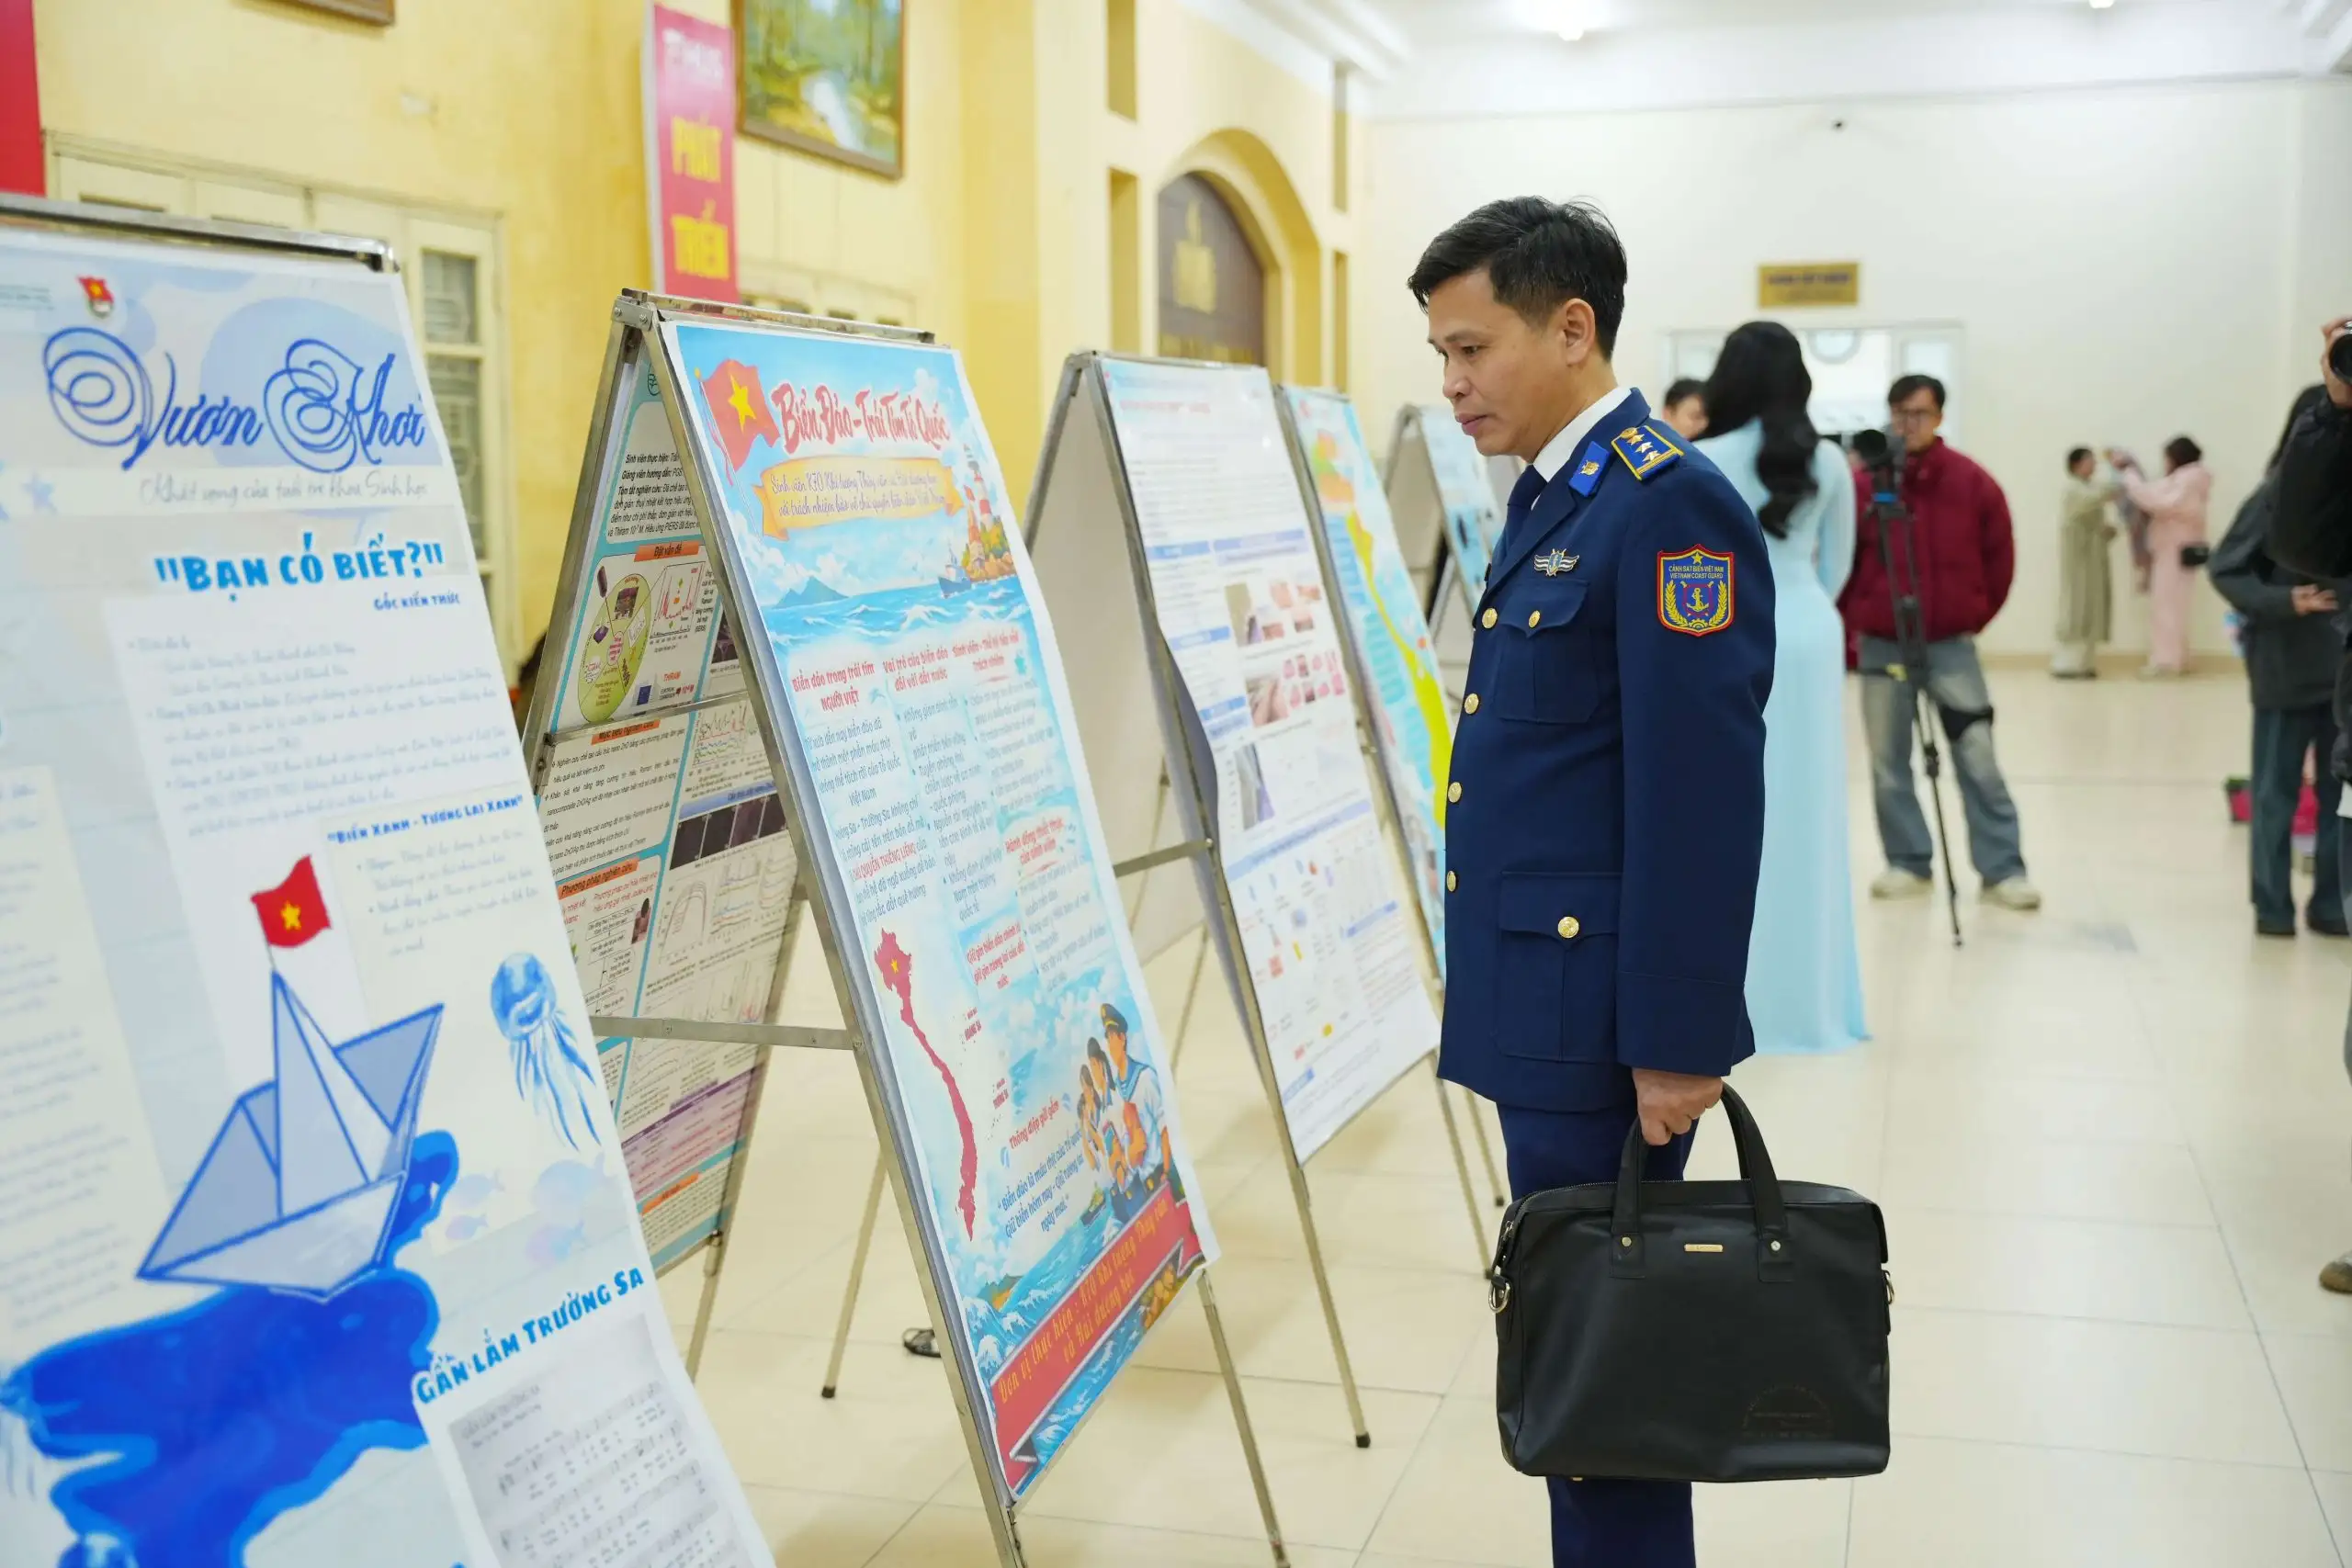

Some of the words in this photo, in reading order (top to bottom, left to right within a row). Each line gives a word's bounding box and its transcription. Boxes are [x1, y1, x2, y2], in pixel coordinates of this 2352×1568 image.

[772, 383, 821, 453] Biển
[815, 385, 853, 444] Đảo
[915, 399, 950, 450] Quốc
[625, 454, 636, 464] Sinh
[636, 454, 647, 463] viên
[635, 468, 646, 479] viên
[279, 532, 324, 585] CÓ
[791, 670, 810, 692] Biển
[810, 671, 825, 687] đảo
[825, 669, 847, 683] trong
[846, 662, 861, 678] trái
[882, 659, 896, 672] Vai
[842, 686, 859, 705] VIỆT
[371, 818, 411, 837] XANH
[465, 803, 484, 818] LAI
[1009, 1128, 1028, 1148] Thông
[1015, 1179, 1028, 1198] đảo
[1005, 1216, 1017, 1238] Giữ
[1014, 1202, 1029, 1227] biển
[1040, 1186, 1053, 1201] nay
[522, 1284, 612, 1345] TRƯỜNG
[613, 1267, 644, 1297] SA
[995, 1372, 1019, 1403] Đơn
